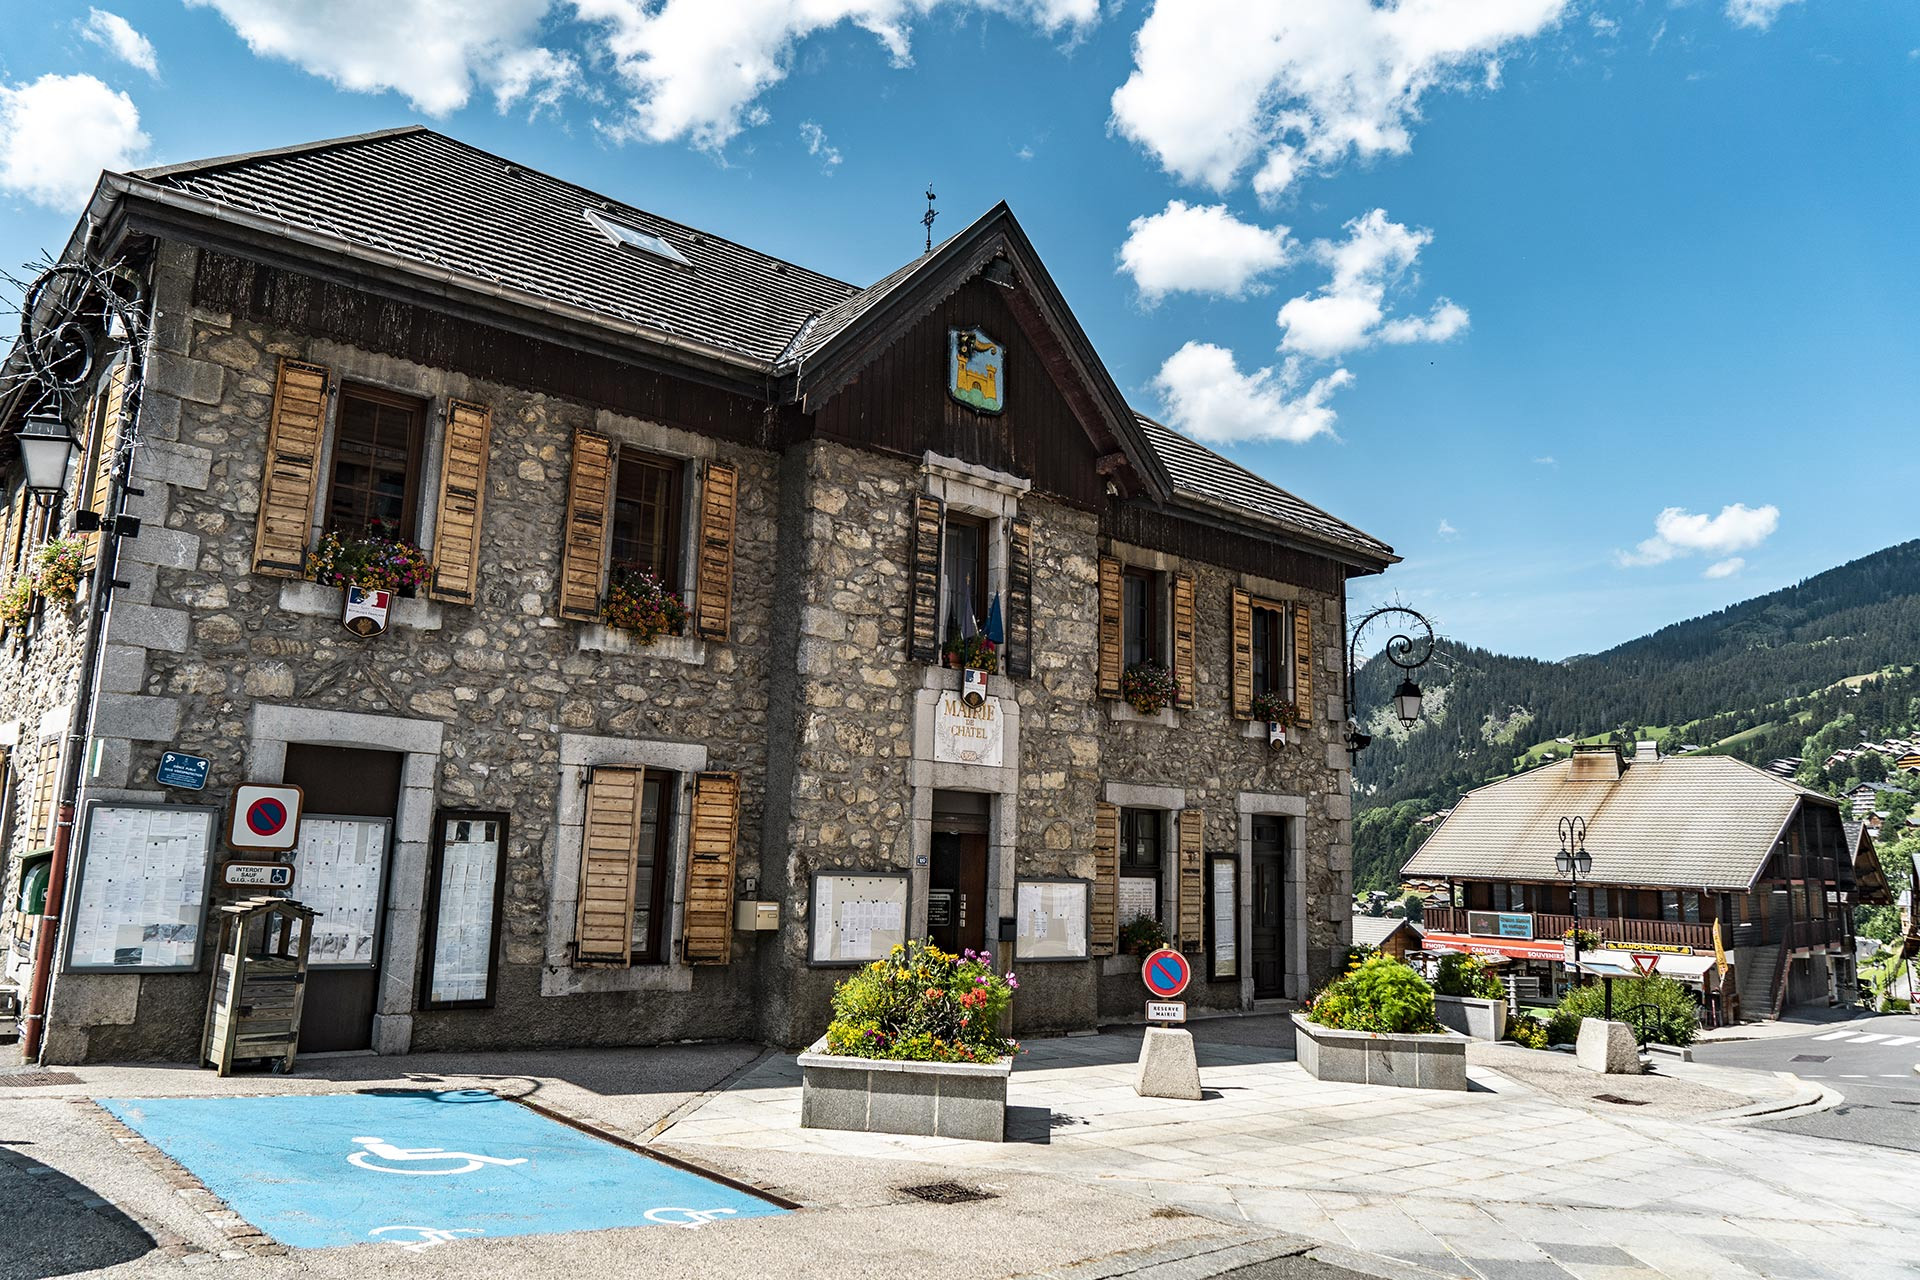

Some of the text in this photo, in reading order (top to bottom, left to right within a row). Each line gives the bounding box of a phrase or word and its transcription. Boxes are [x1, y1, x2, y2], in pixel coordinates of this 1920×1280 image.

[944, 699, 995, 721] MAIRIE
[1471, 947, 1501, 955] CADEAUX
[1527, 951, 1565, 960] SOUVENIRS
